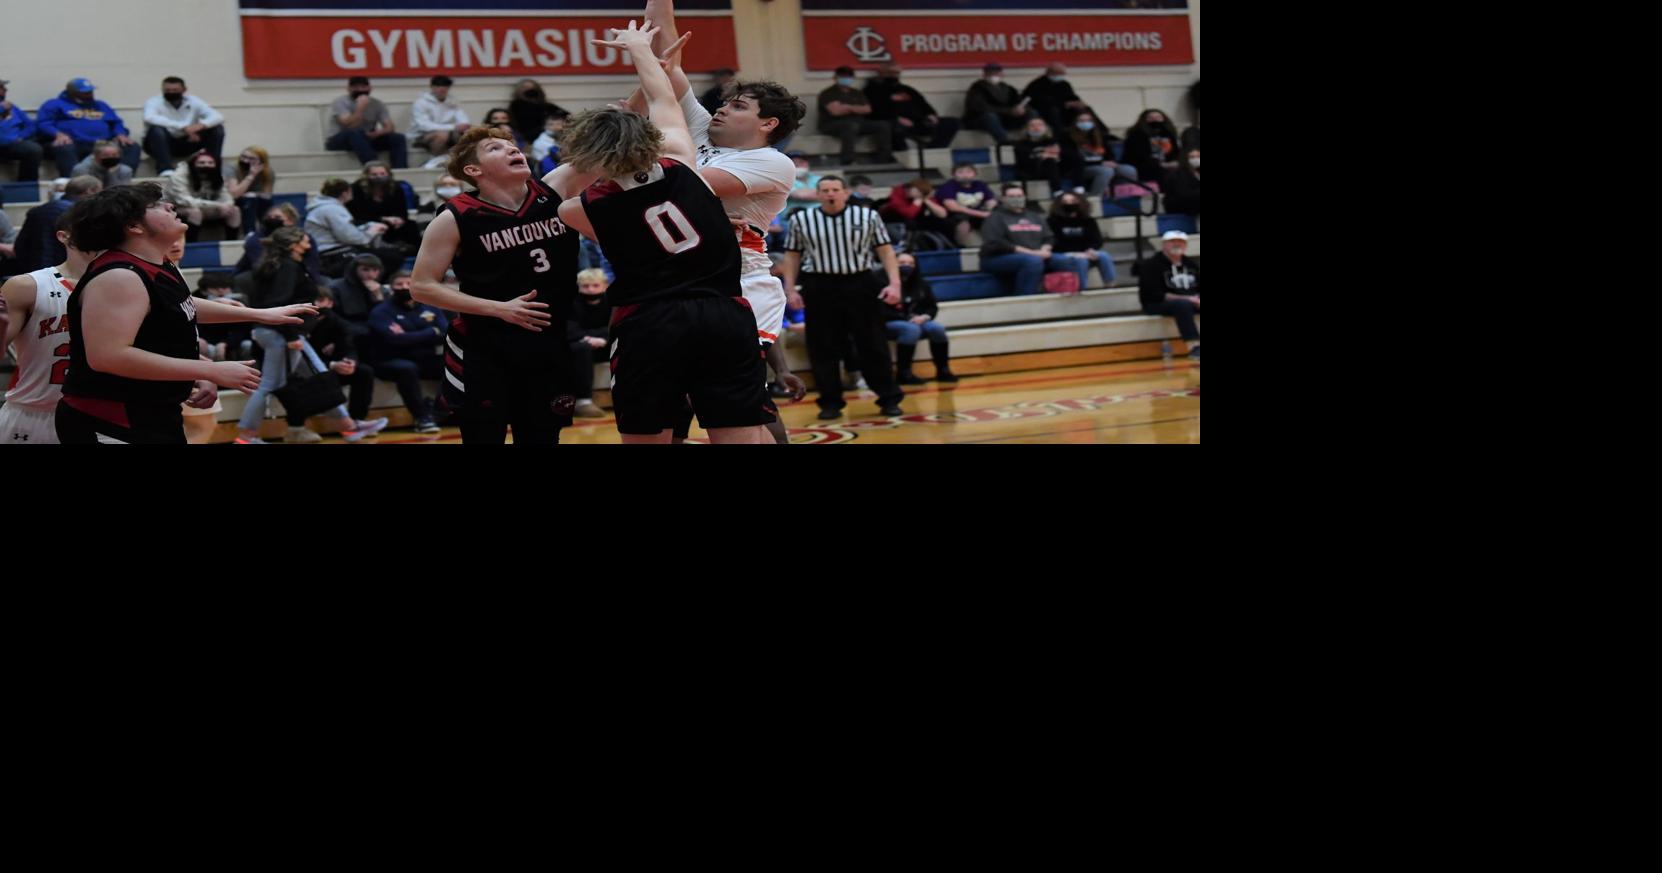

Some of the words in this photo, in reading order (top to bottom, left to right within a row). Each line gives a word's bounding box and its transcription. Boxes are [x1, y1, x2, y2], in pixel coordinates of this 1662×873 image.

[331, 28, 633, 69] GYMNASIU
[901, 34, 1006, 52] PROGRAM
[1014, 33, 1036, 51] OF
[1042, 32, 1162, 50] CHAMPIONS
[645, 200, 700, 255] 0
[529, 248, 551, 273] 3
